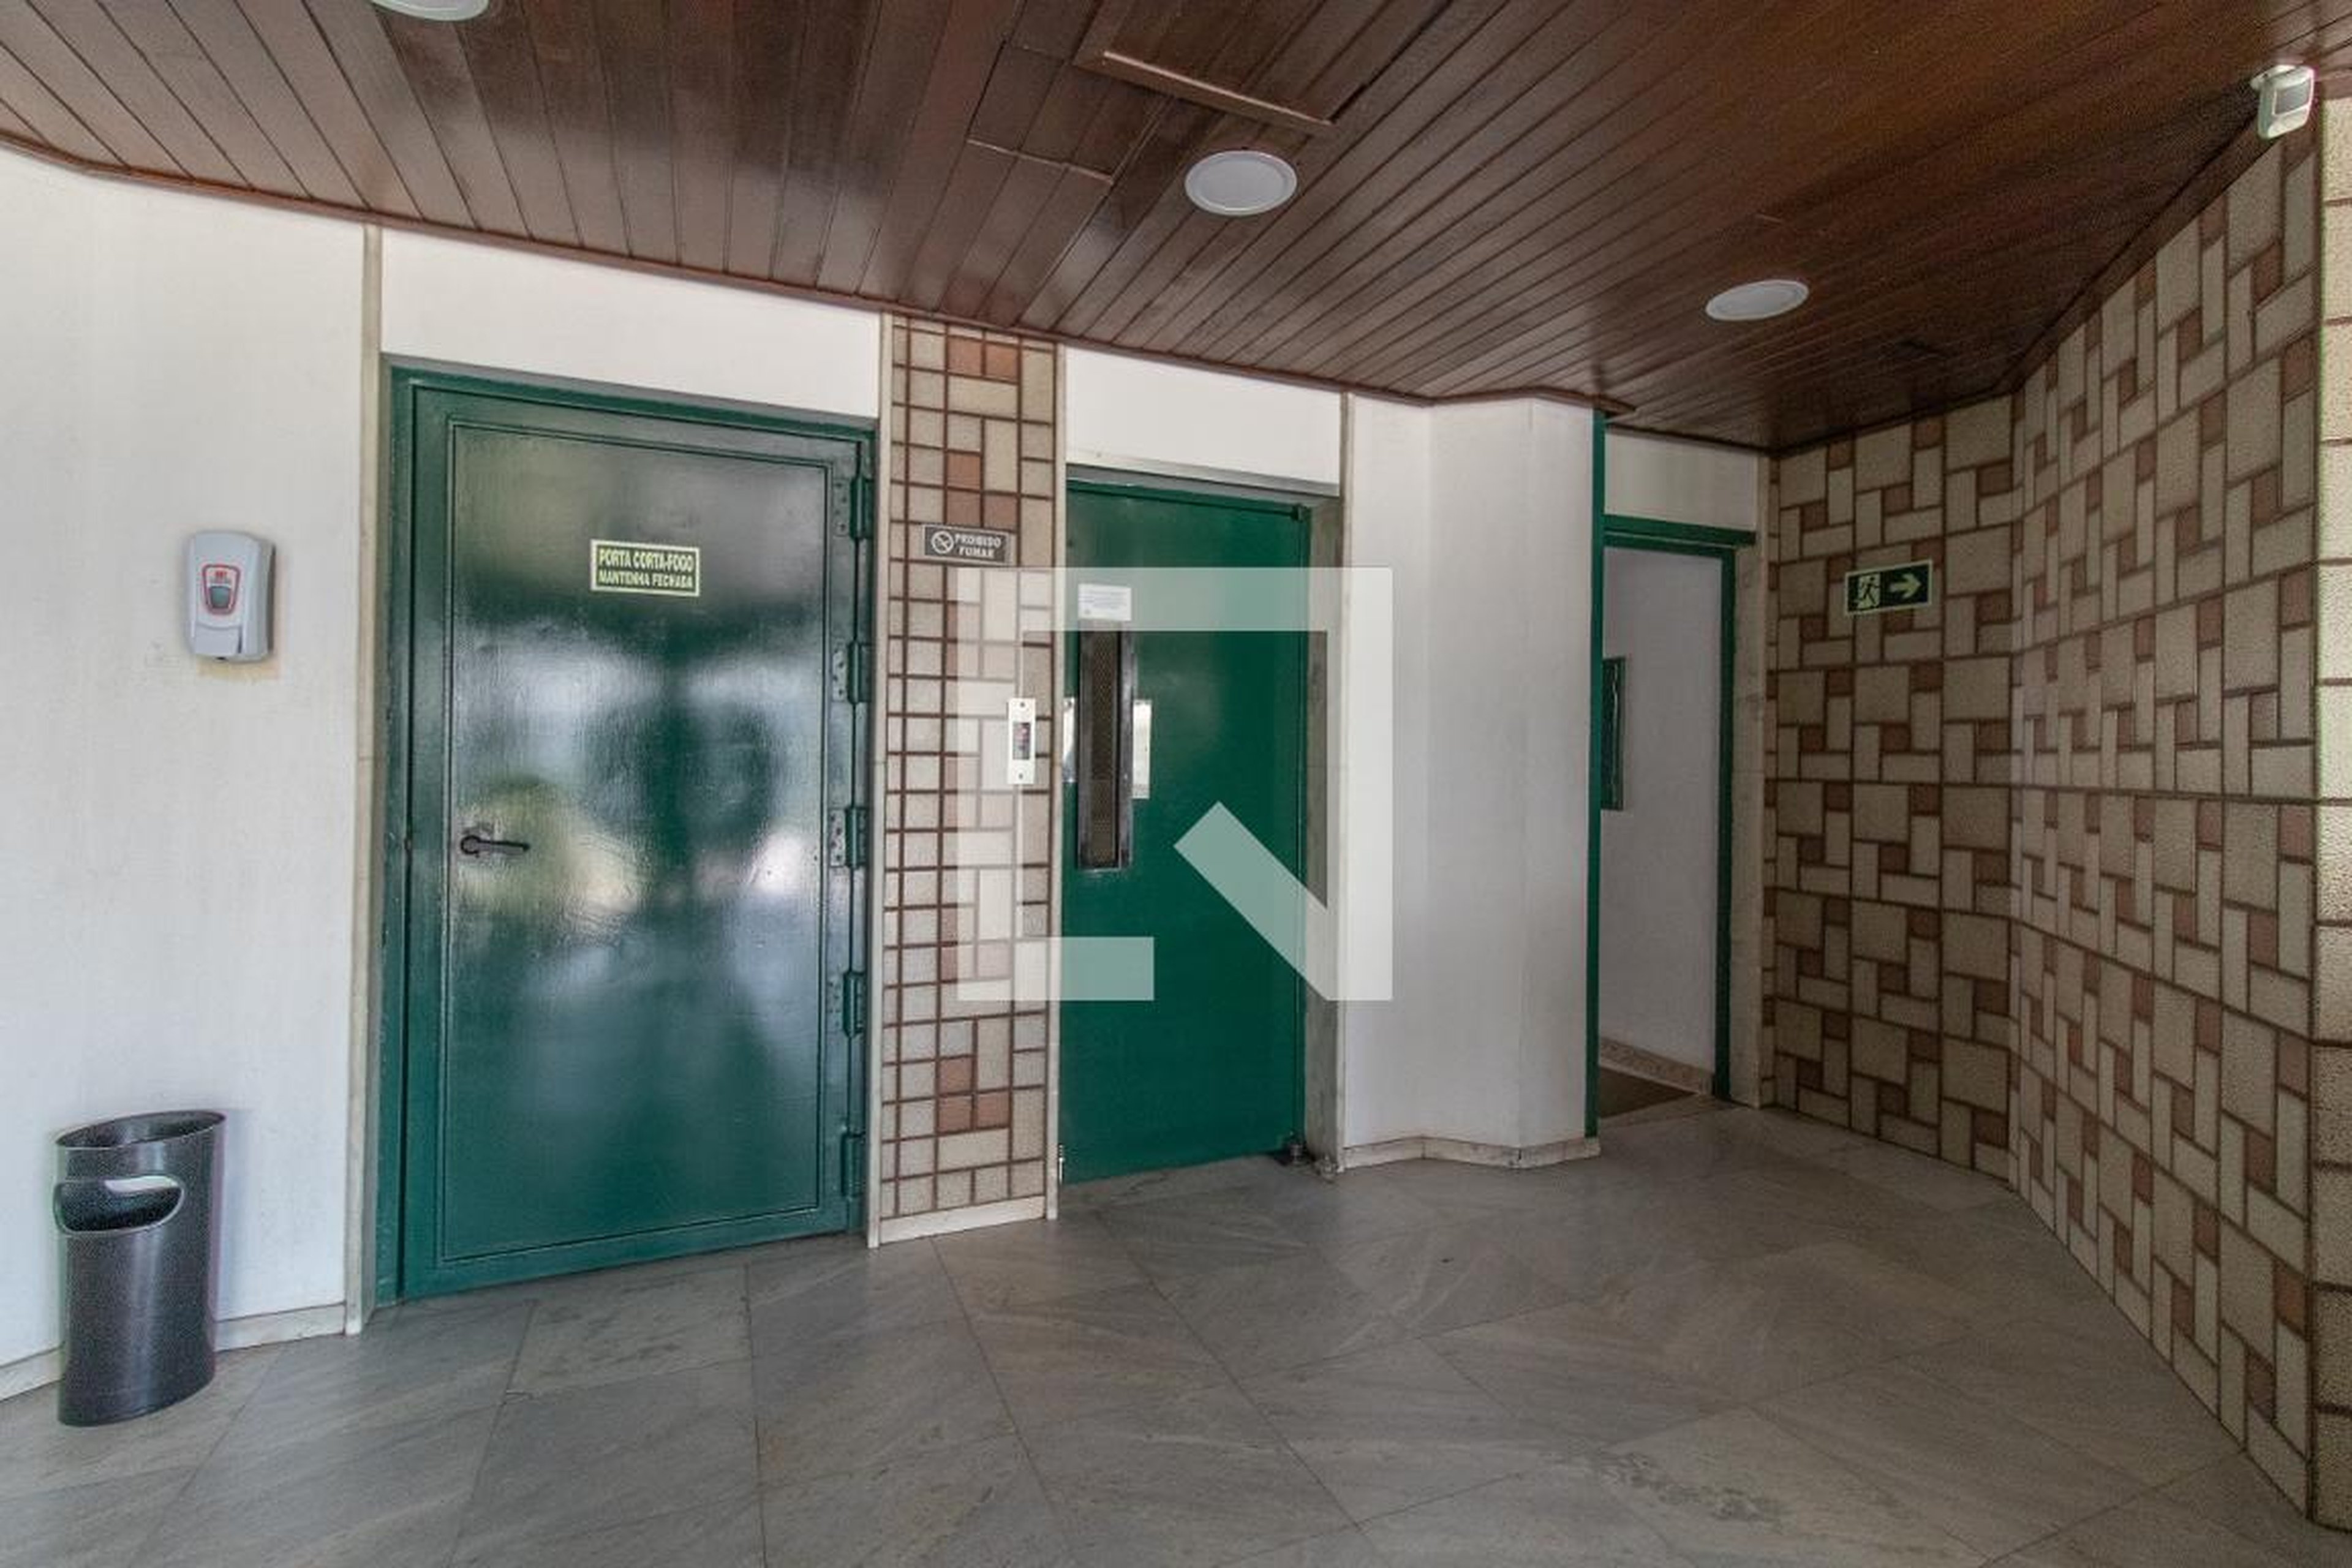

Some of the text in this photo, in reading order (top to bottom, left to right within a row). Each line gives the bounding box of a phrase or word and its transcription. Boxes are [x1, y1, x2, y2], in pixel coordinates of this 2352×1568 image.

[955, 533, 1001, 548] PROIBIDO
[959, 546, 995, 558] FUMAR
[599, 549, 695, 573] PORTA CORTA-FOGO
[598, 570, 693, 589] MANTENHA FECHADA
